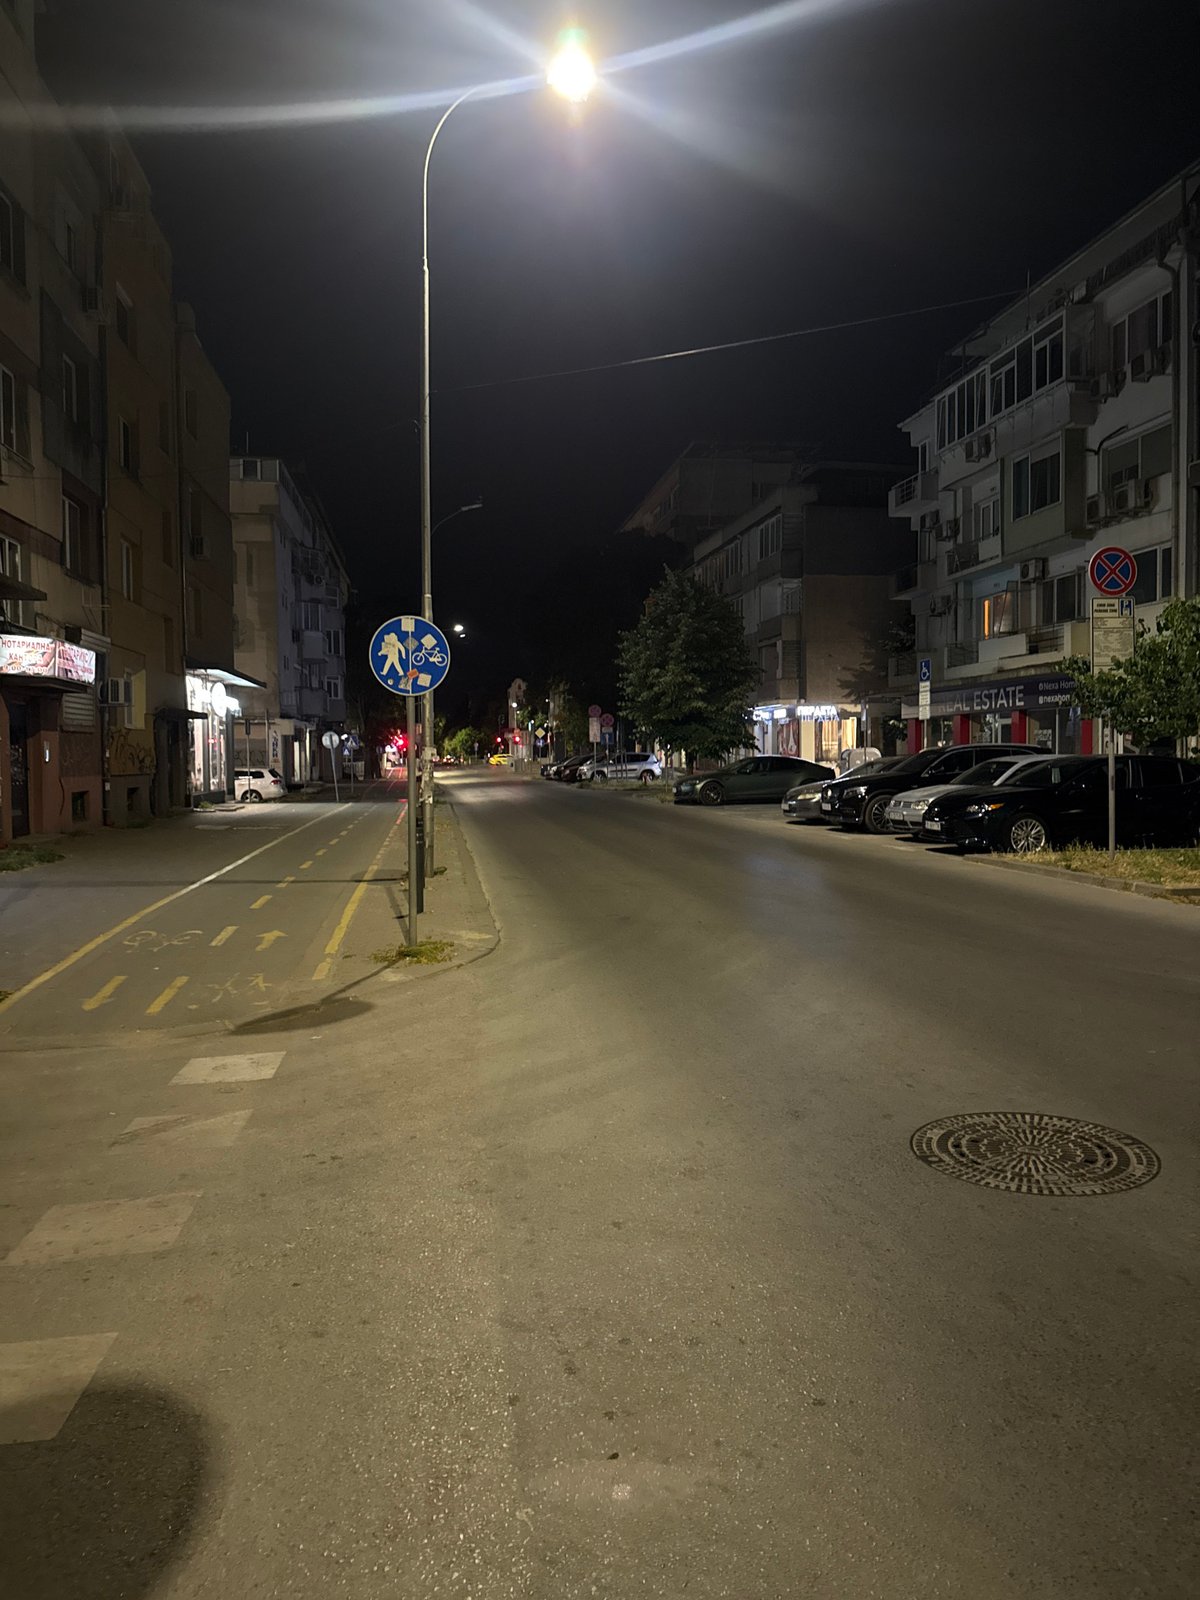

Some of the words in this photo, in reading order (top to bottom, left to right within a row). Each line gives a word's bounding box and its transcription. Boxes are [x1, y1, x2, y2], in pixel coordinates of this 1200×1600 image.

[2, 639, 50, 651] НОТАРИАЛНА
[1044, 682, 1059, 690] Nexa
[973, 686, 1025, 711] ESTATE
